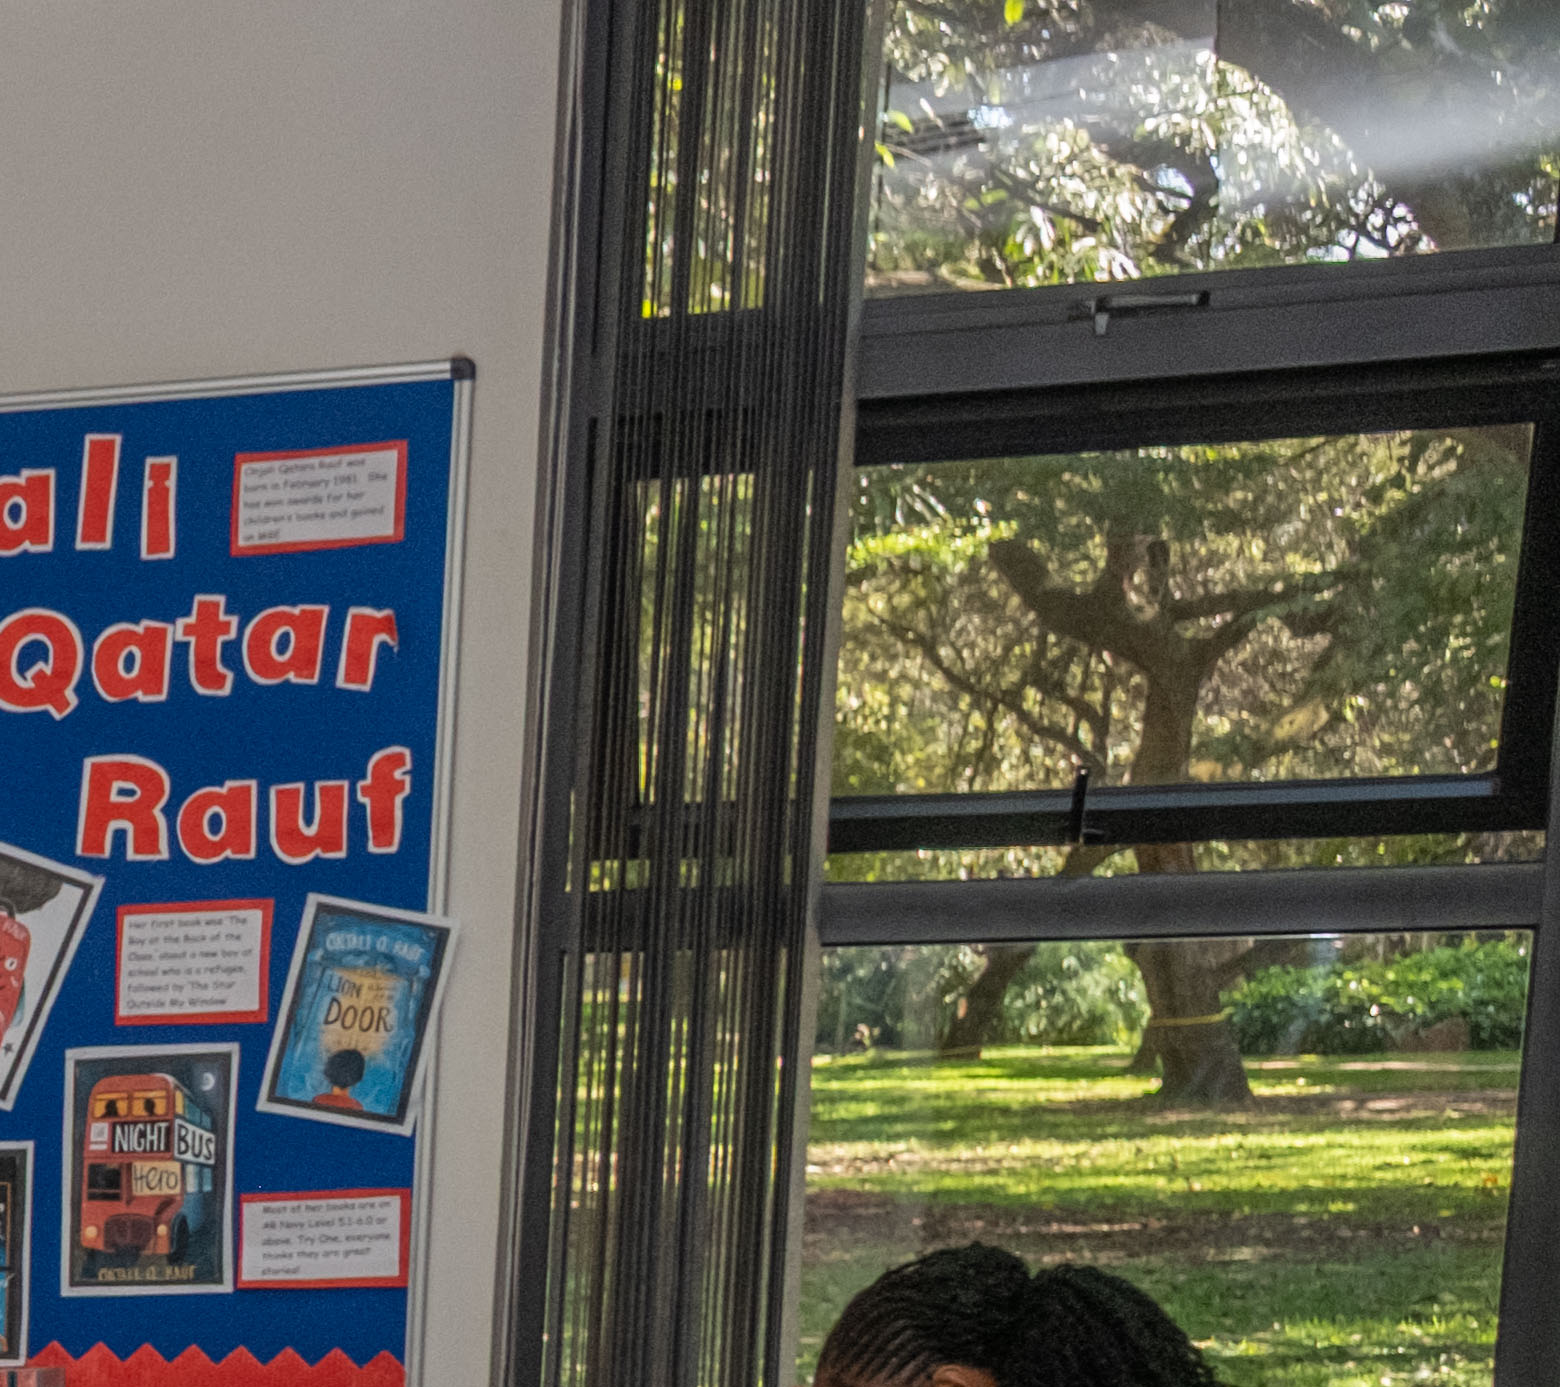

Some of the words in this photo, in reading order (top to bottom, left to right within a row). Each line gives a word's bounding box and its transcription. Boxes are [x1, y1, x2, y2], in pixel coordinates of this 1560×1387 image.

[75, 746, 412, 864] Rauf
[323, 997, 394, 1033] DOOR
[115, 1123, 169, 1152] NIGHT
[177, 1124, 214, 1161] BUS
